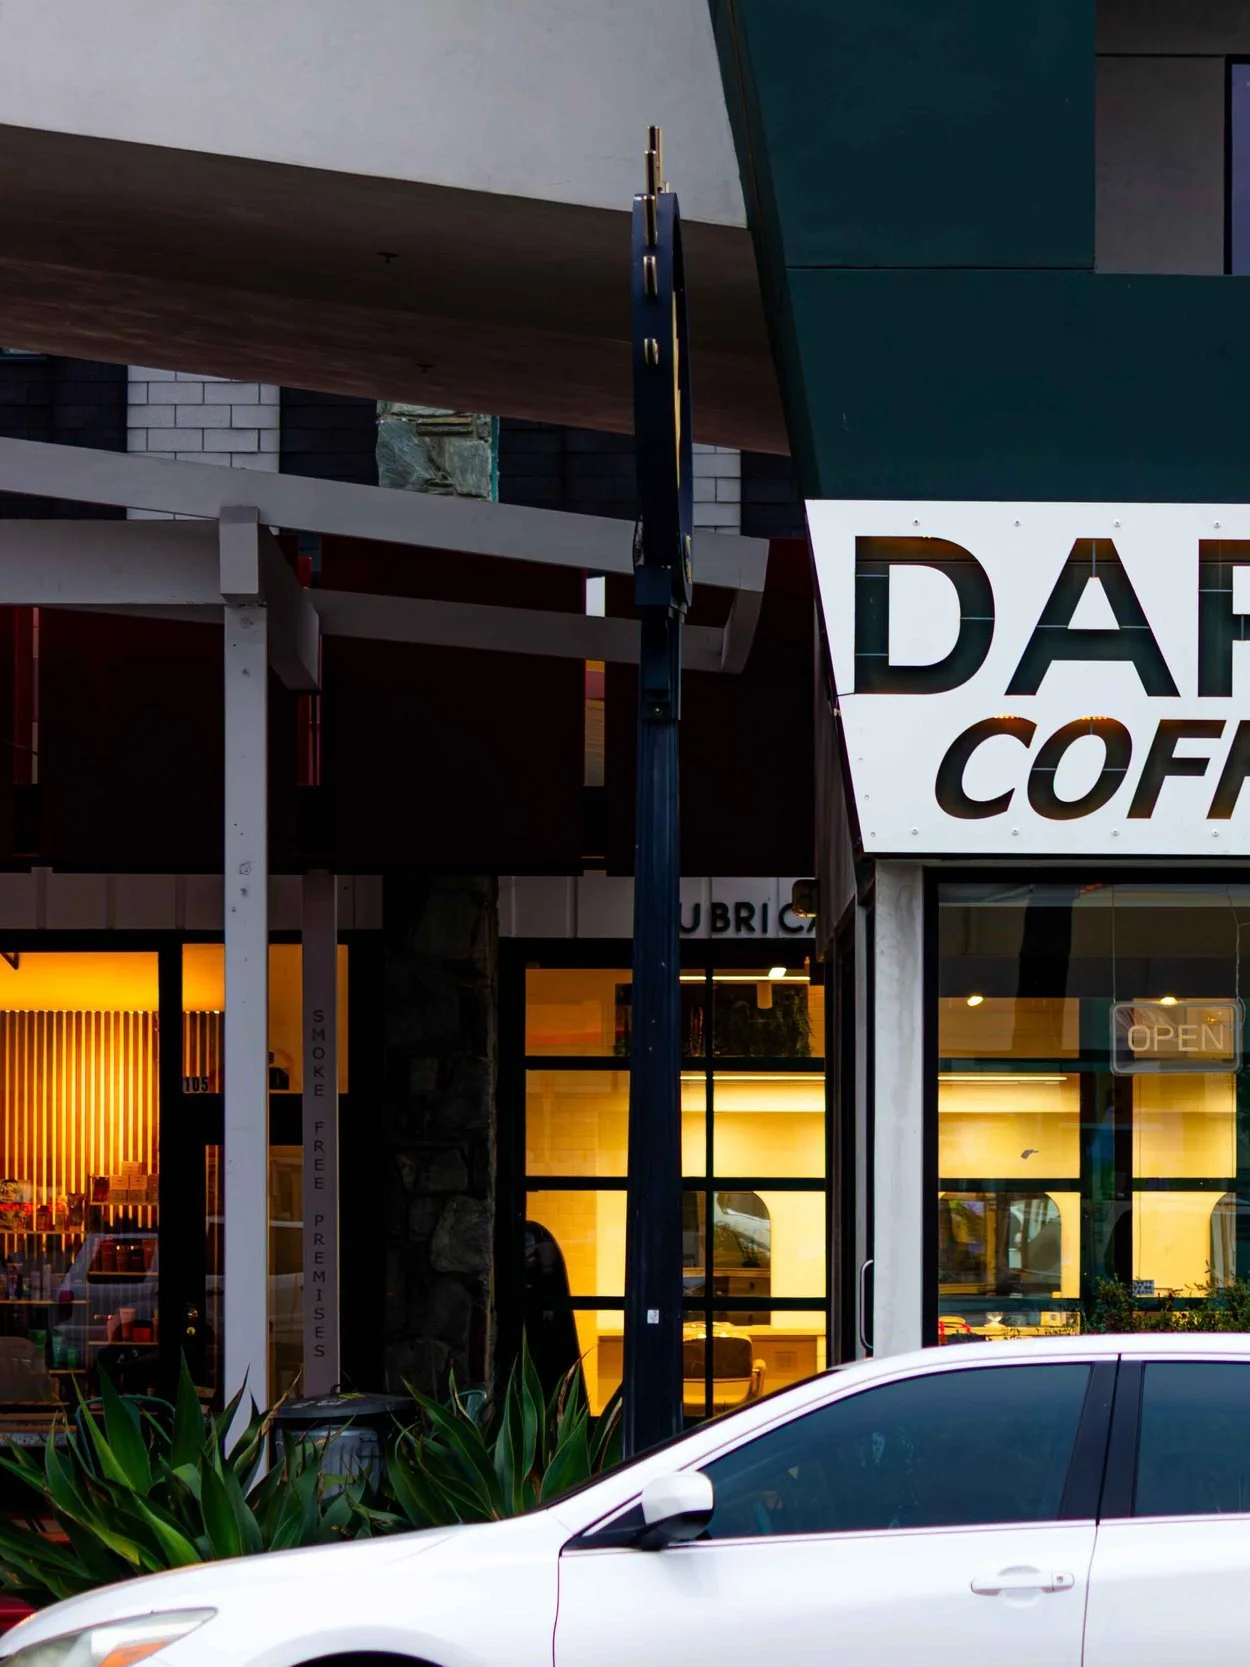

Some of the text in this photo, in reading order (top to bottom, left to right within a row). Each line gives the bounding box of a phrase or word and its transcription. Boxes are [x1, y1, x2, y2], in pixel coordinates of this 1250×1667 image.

[1128, 1024, 1224, 1052] OPEN
[312, 1009, 326, 1358] SMOKE FREE PREMISES
